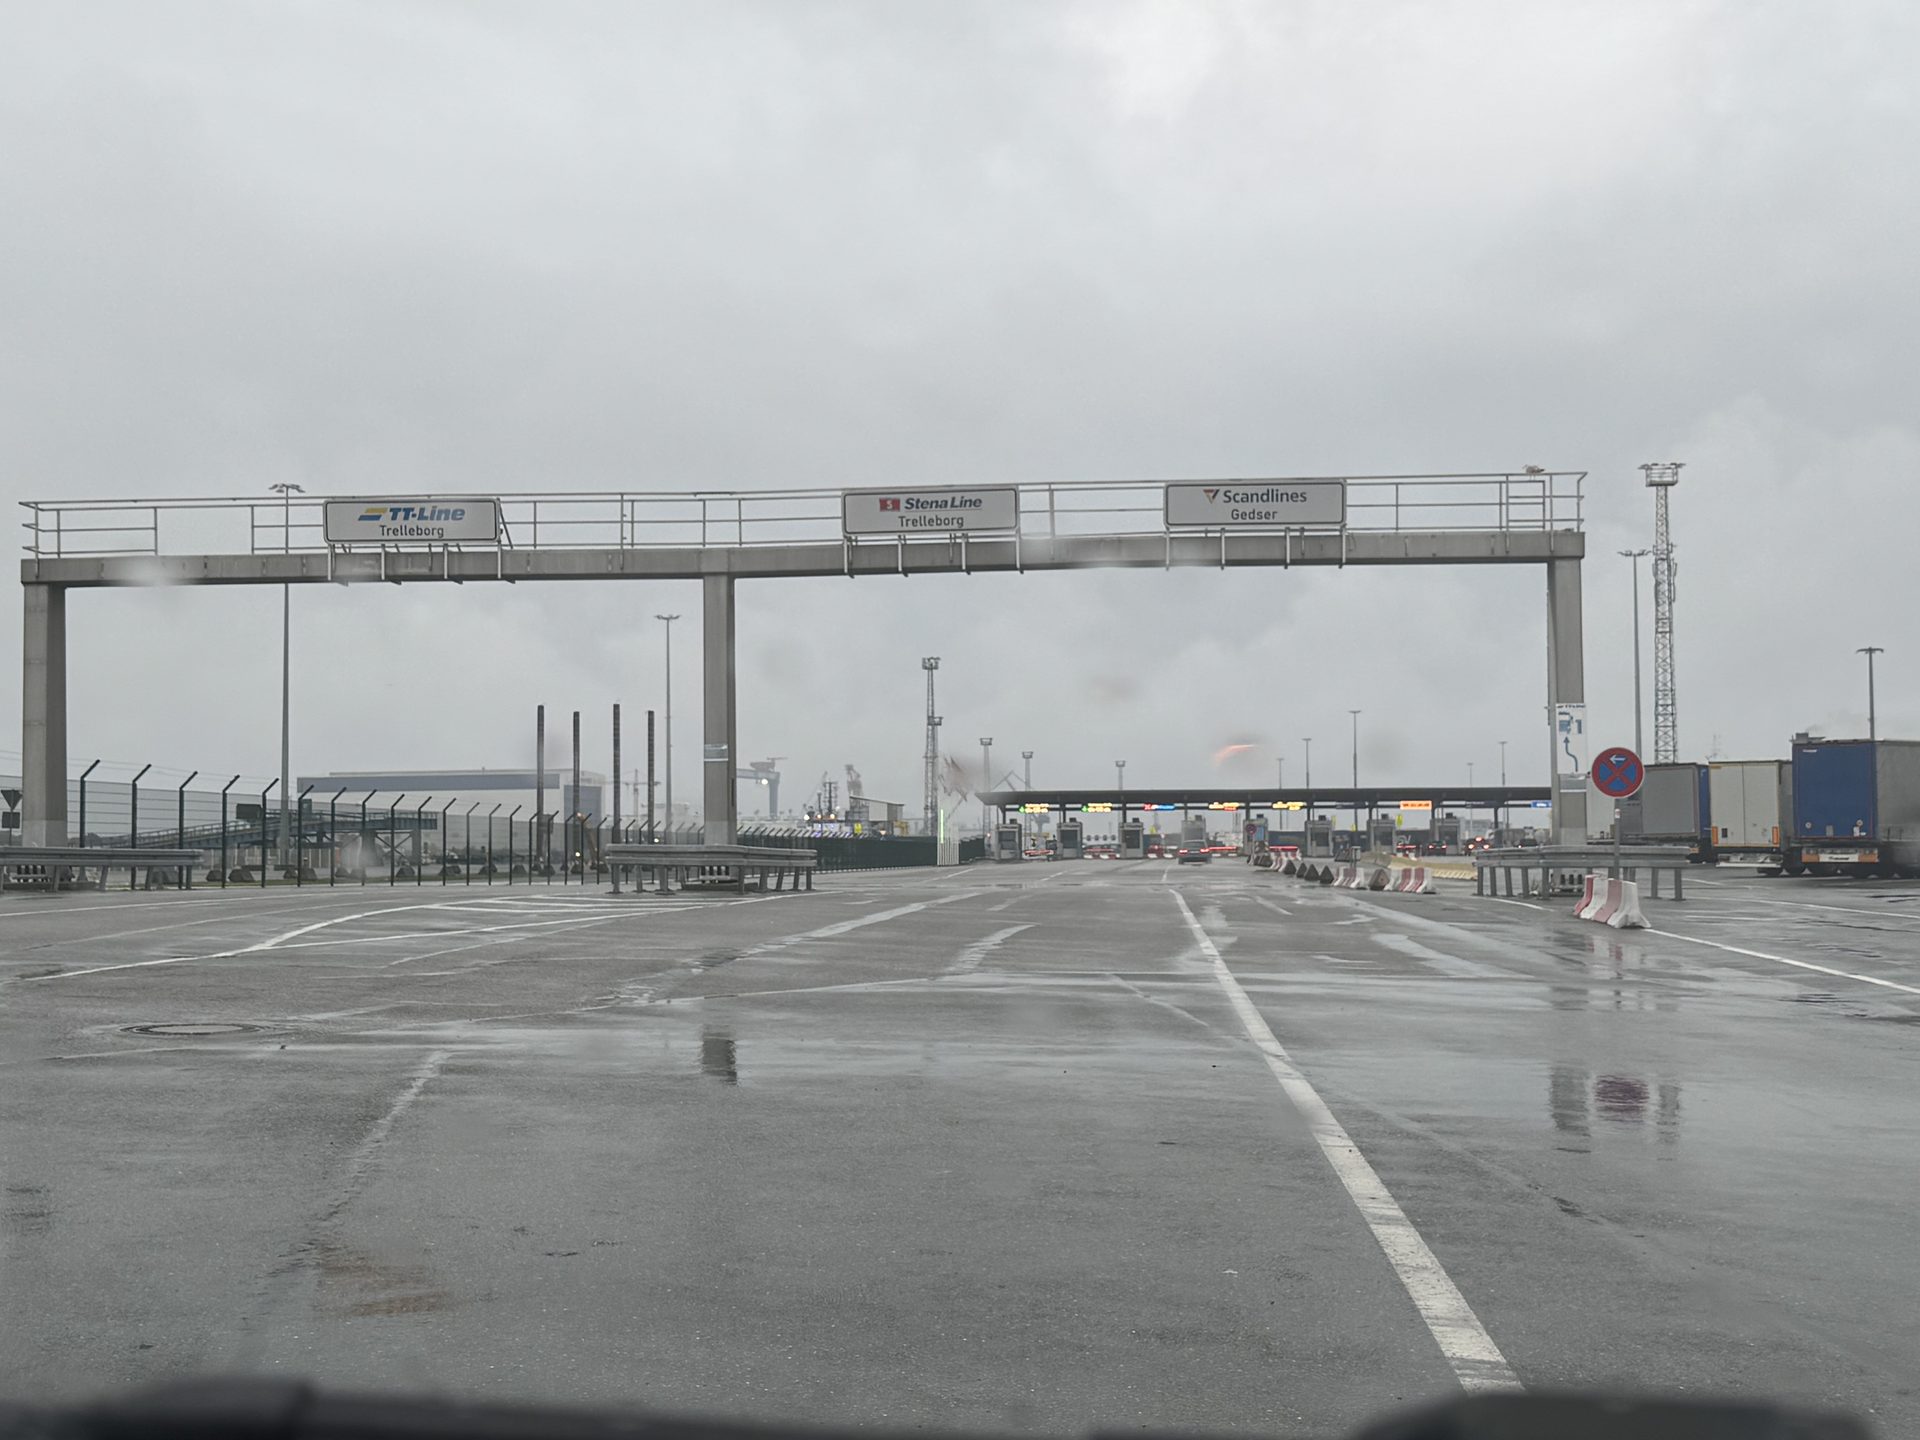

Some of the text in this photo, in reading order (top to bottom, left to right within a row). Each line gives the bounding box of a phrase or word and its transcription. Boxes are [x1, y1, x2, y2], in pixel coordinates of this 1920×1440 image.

[1223, 488, 1307, 503] Scandlines
[389, 506, 466, 521] TT-Line
[1231, 508, 1278, 520] Gedser
[898, 515, 964, 528] Trelleborg
[380, 525, 444, 539] Trelleborg
